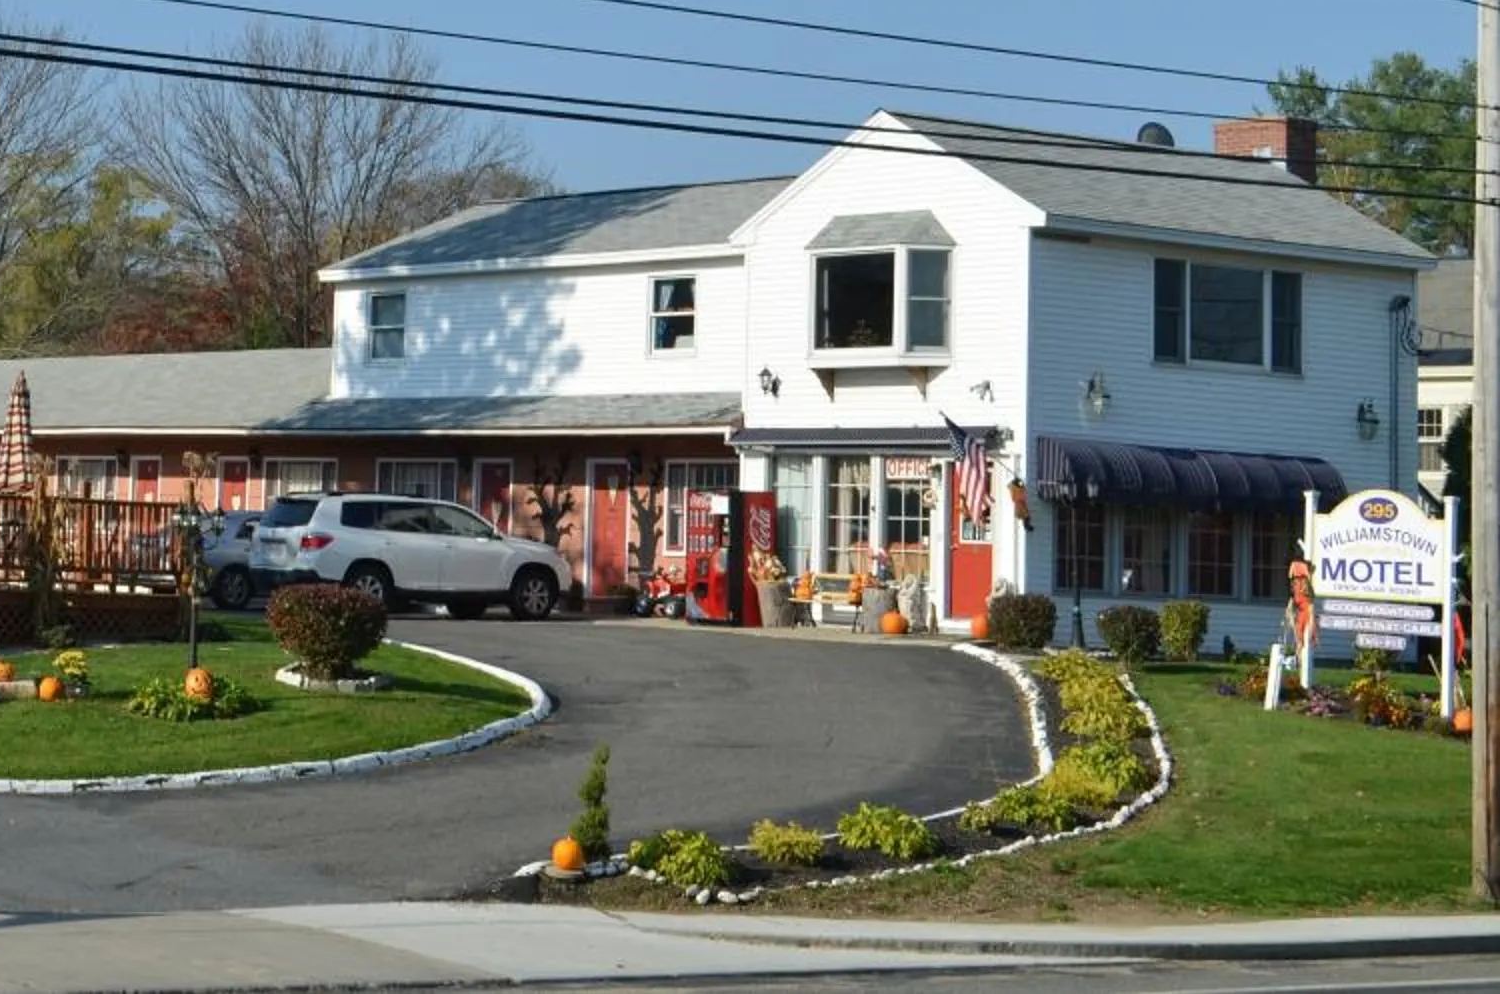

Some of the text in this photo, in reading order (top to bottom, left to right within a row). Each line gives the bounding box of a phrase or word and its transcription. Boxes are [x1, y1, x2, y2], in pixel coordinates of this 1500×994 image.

[1363, 502, 1395, 519] 295
[1320, 527, 1438, 556] WILLIAMSTOWN
[1321, 557, 1435, 586] MOTEL
